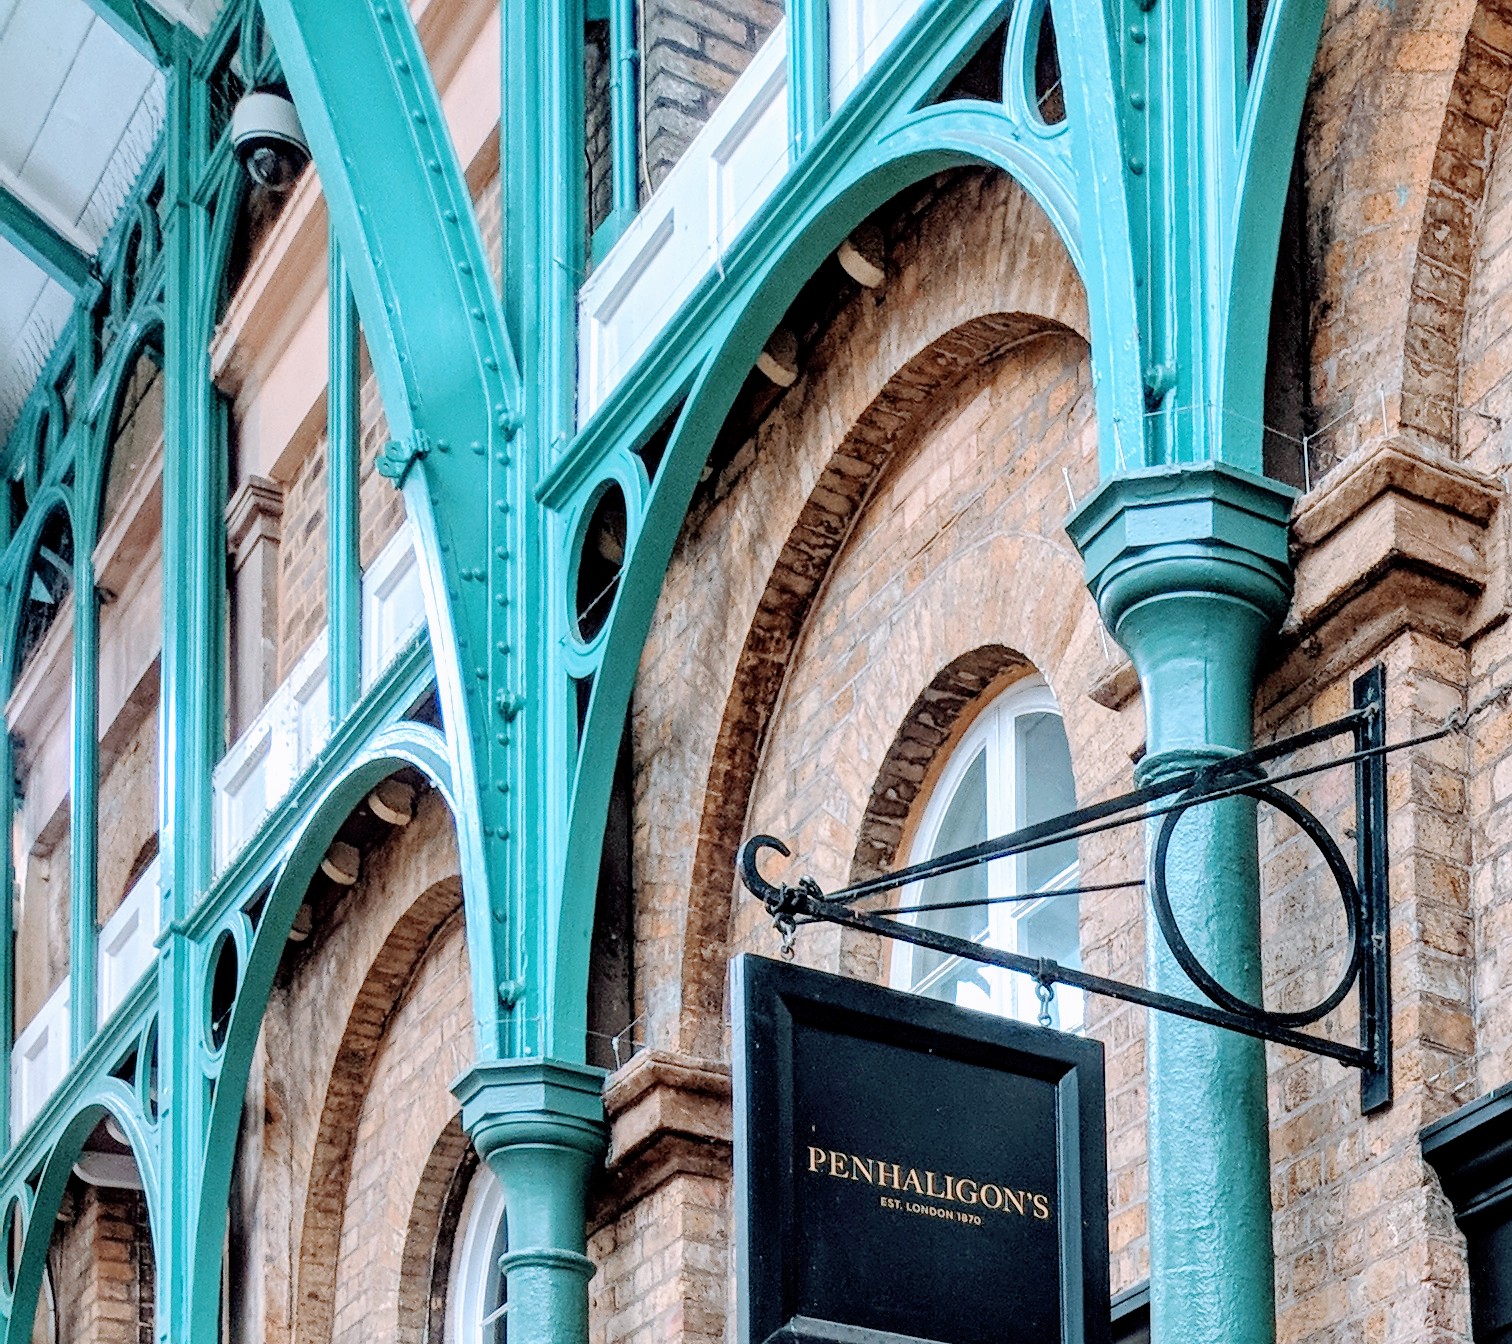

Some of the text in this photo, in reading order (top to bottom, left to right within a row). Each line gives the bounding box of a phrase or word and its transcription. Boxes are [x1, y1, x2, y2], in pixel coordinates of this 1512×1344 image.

[807, 1146, 1051, 1221] PENHALIGON'S
[880, 1196, 983, 1227] EST. LONDON 1870
